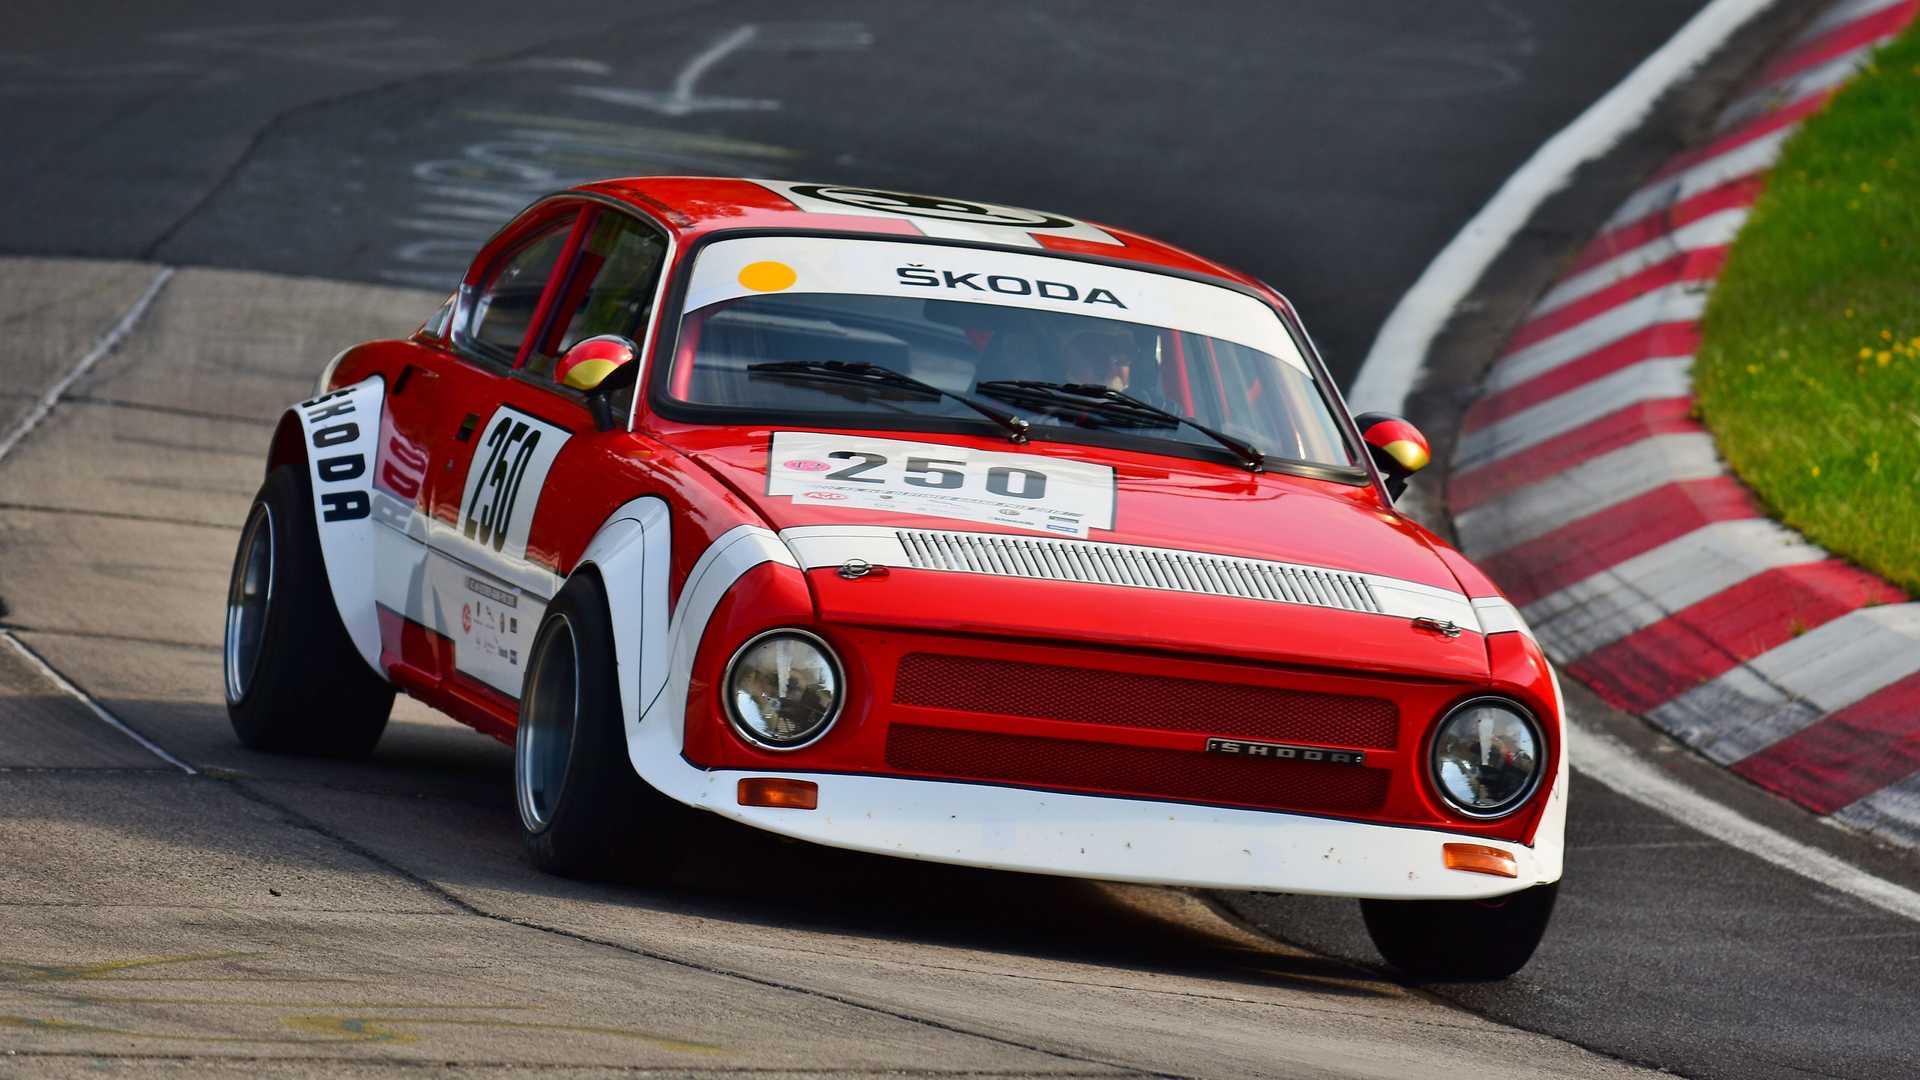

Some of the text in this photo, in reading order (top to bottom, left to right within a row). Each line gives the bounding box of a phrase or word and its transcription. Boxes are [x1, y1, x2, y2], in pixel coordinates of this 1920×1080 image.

[896, 263, 1129, 310] ŠKODA
[464, 417, 541, 552] 250
[826, 451, 1047, 500] 250
